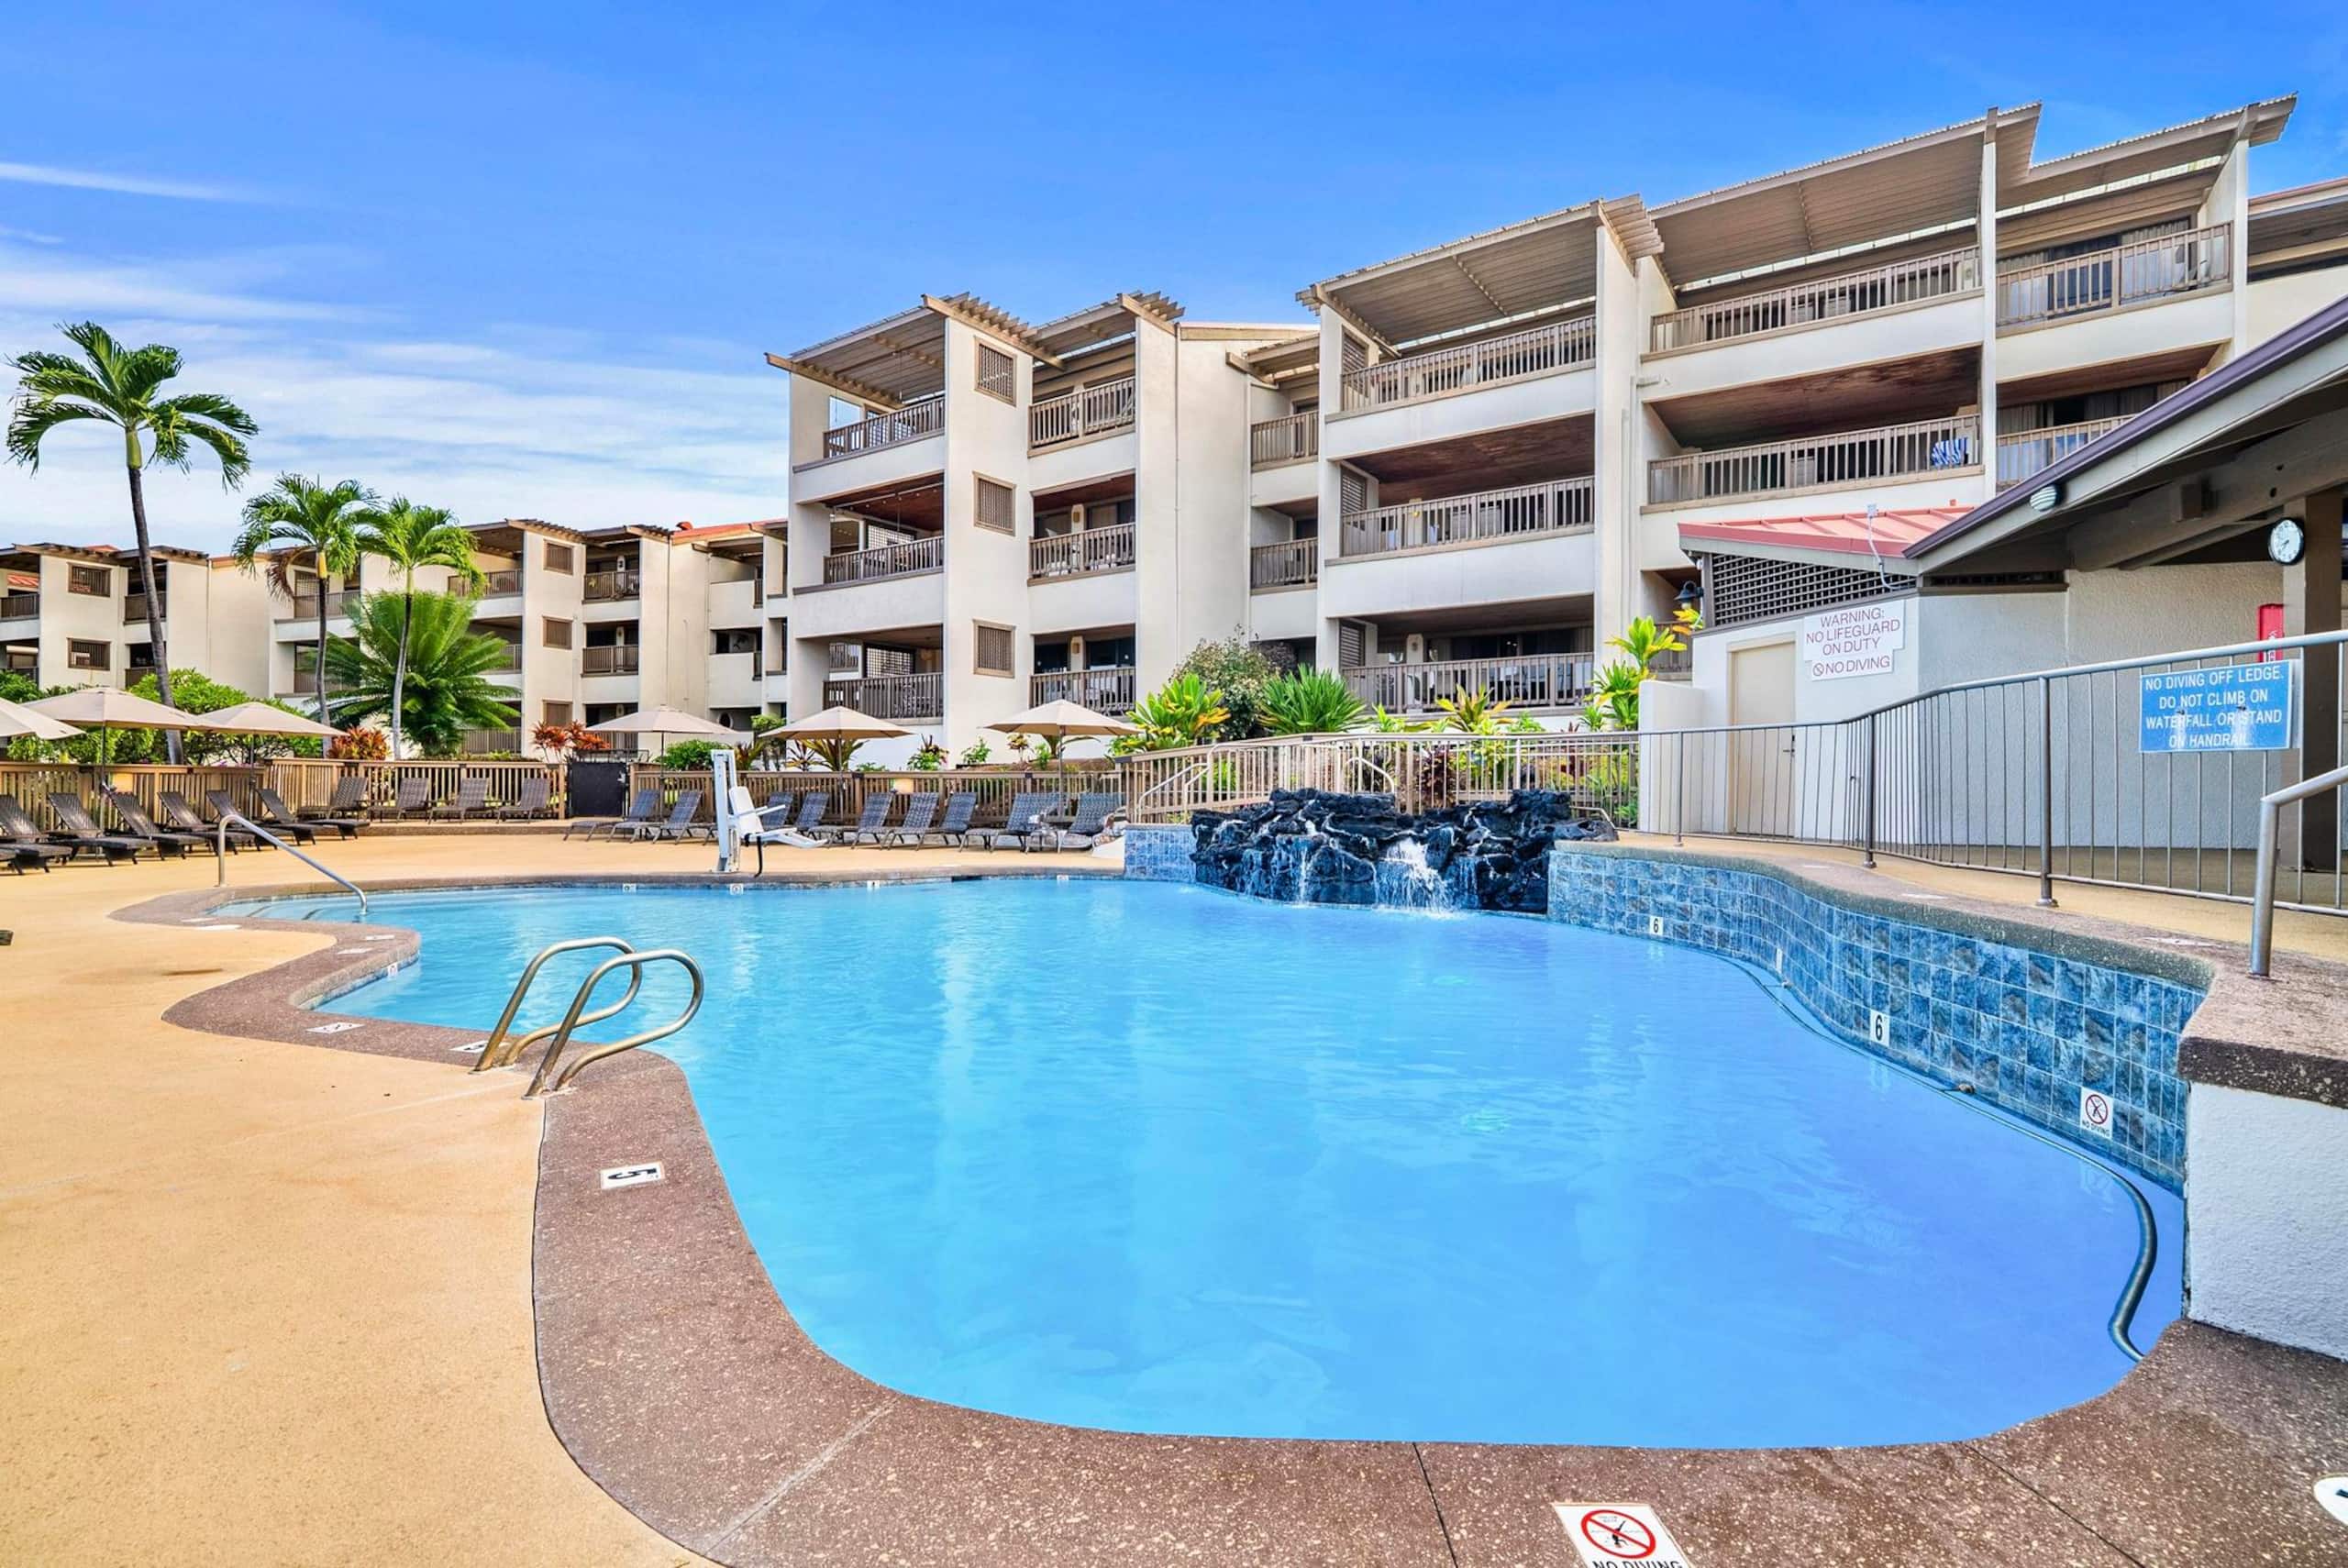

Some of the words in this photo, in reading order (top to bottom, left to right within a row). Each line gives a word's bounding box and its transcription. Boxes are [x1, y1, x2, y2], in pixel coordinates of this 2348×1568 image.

[1821, 607, 1885, 627] WARNING:
[1806, 631, 1824, 644] NO
[1826, 619, 1900, 641] LIFEGUARD
[1822, 643, 1841, 656] ON
[1844, 636, 1880, 653] DUTY
[1825, 661, 1844, 674] NO
[1846, 656, 1890, 672] DIVING
[2145, 678, 2162, 690] NO
[2166, 673, 2205, 689] DIVING
[2209, 670, 2233, 685] OFF
[2239, 666, 2284, 683] LEDGE.
[2159, 696, 2176, 710] DO
[2180, 694, 2202, 708] NOT
[2208, 690, 2245, 705] CLIMB
[2250, 689, 2268, 703] ON
[2145, 714, 2212, 730] WATERFALL
[2217, 712, 2235, 726] OR
[2240, 709, 2282, 724] STAND
[2168, 734, 2186, 748] ON
[1654, 918, 1659, 933] 6
[1876, 1014, 1883, 1041] 6
